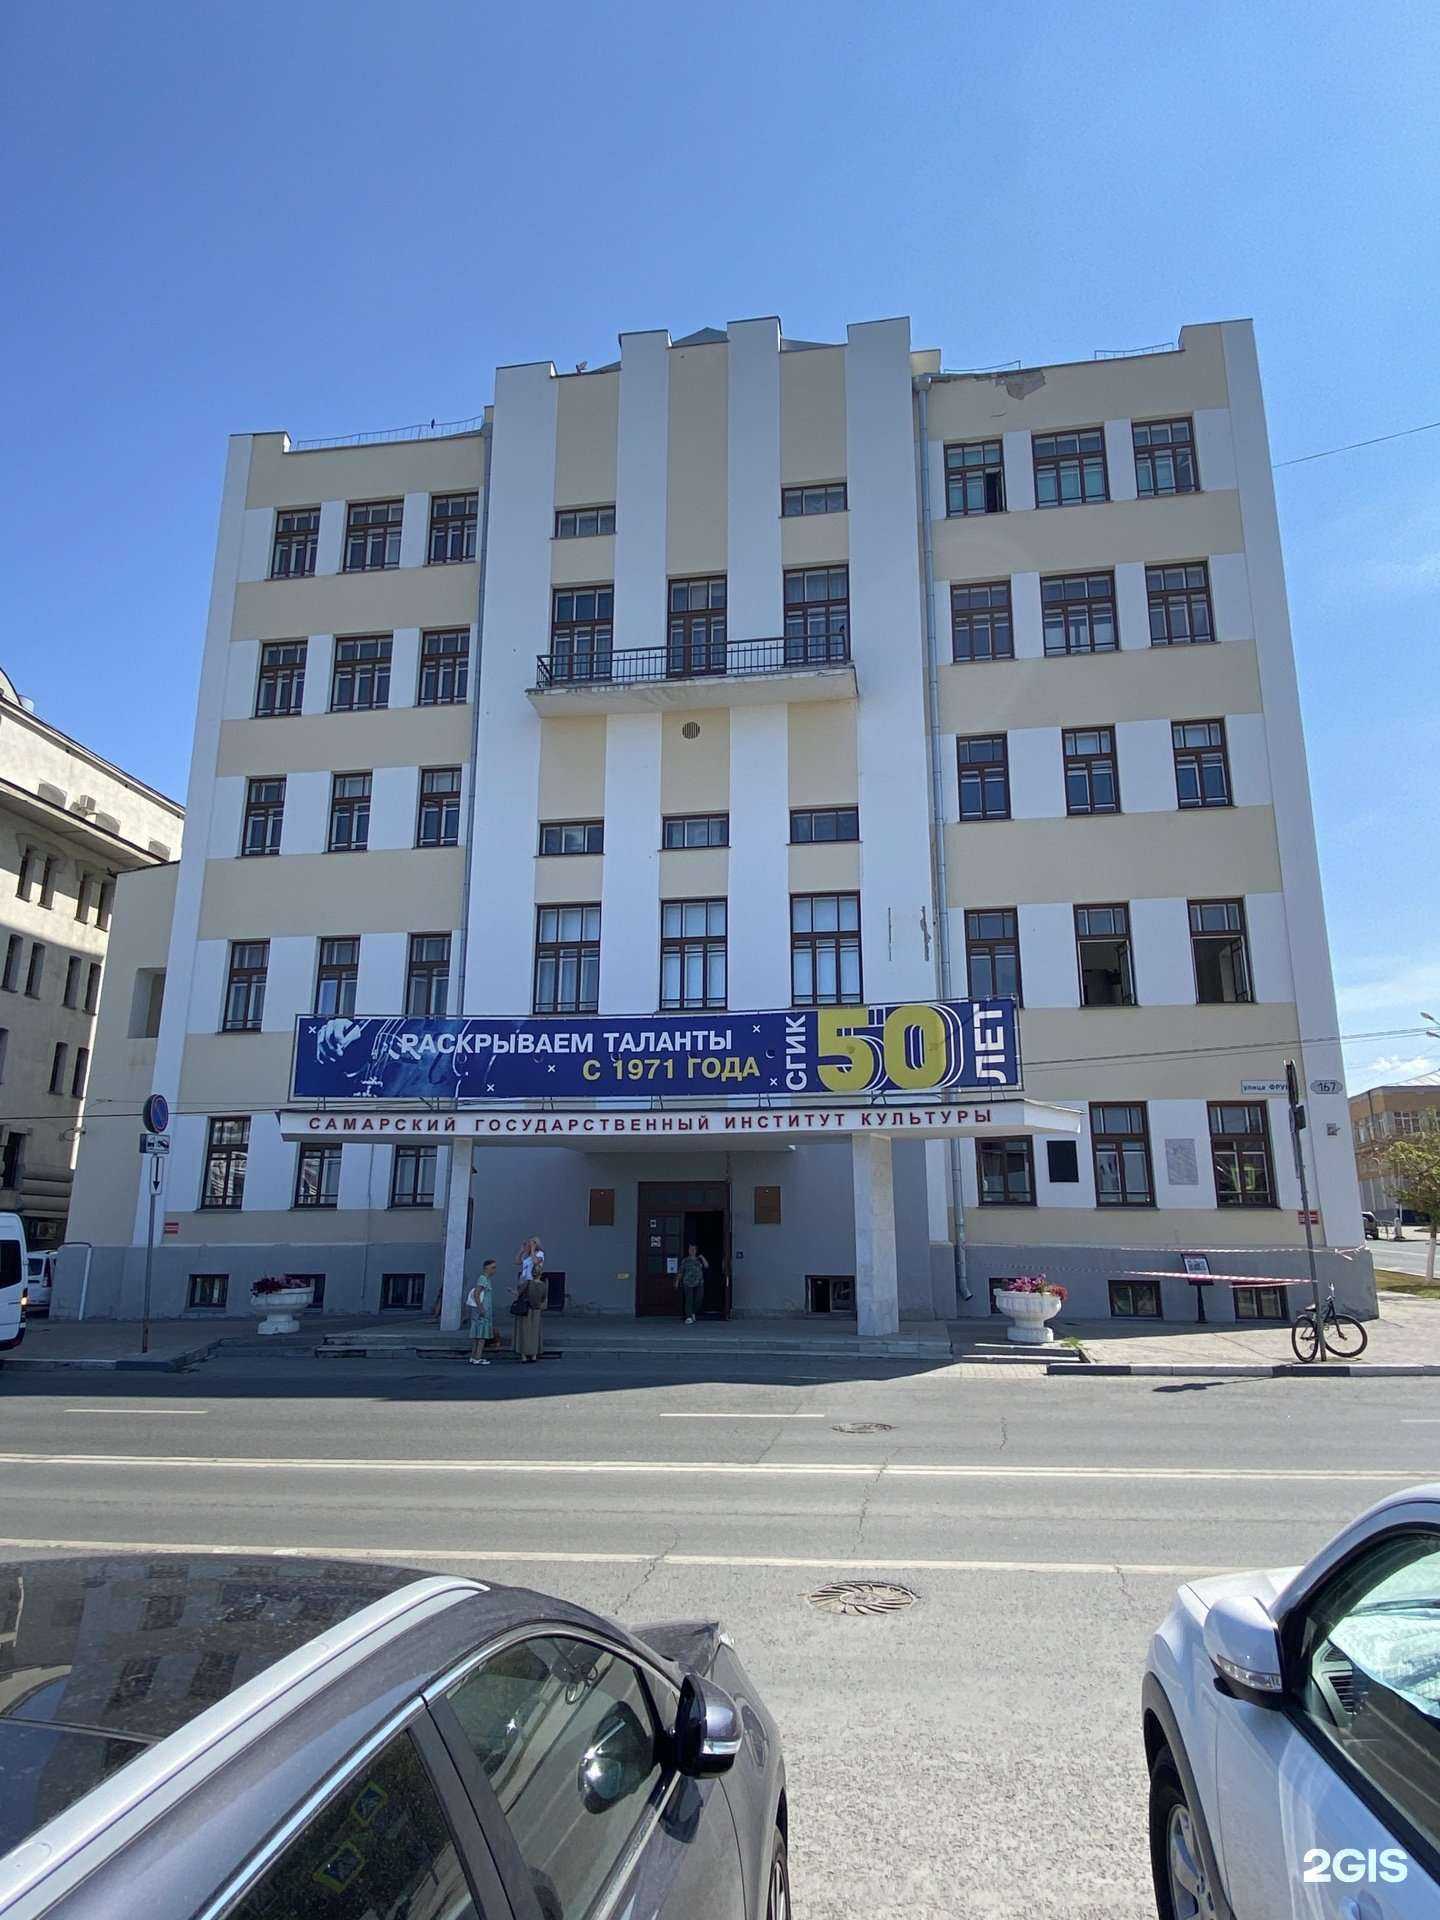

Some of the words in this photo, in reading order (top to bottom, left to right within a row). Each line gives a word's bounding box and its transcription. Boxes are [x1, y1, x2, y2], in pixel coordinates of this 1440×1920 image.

[401, 1032, 593, 1054] РАСКРЫВАЕМ
[603, 1030, 732, 1053] ТАЛАНТЫ
[785, 1015, 807, 1091] СГИК
[816, 1005, 948, 1092] 50
[972, 1003, 1007, 1085] ЛЕТ
[582, 1059, 601, 1081] С
[613, 1058, 674, 1080] 1971
[688, 1056, 761, 1082] ГОДА
[1318, 1082, 1336, 1092] 167
[308, 1116, 456, 1132] САМАРСКИЙ
[475, 1116, 710, 1134] ГОСУДАРСТВЕННЫЙ
[724, 1113, 846, 1129] ИНСТИТУТ
[861, 1109, 992, 1126] КУЛЬТУРЫ
